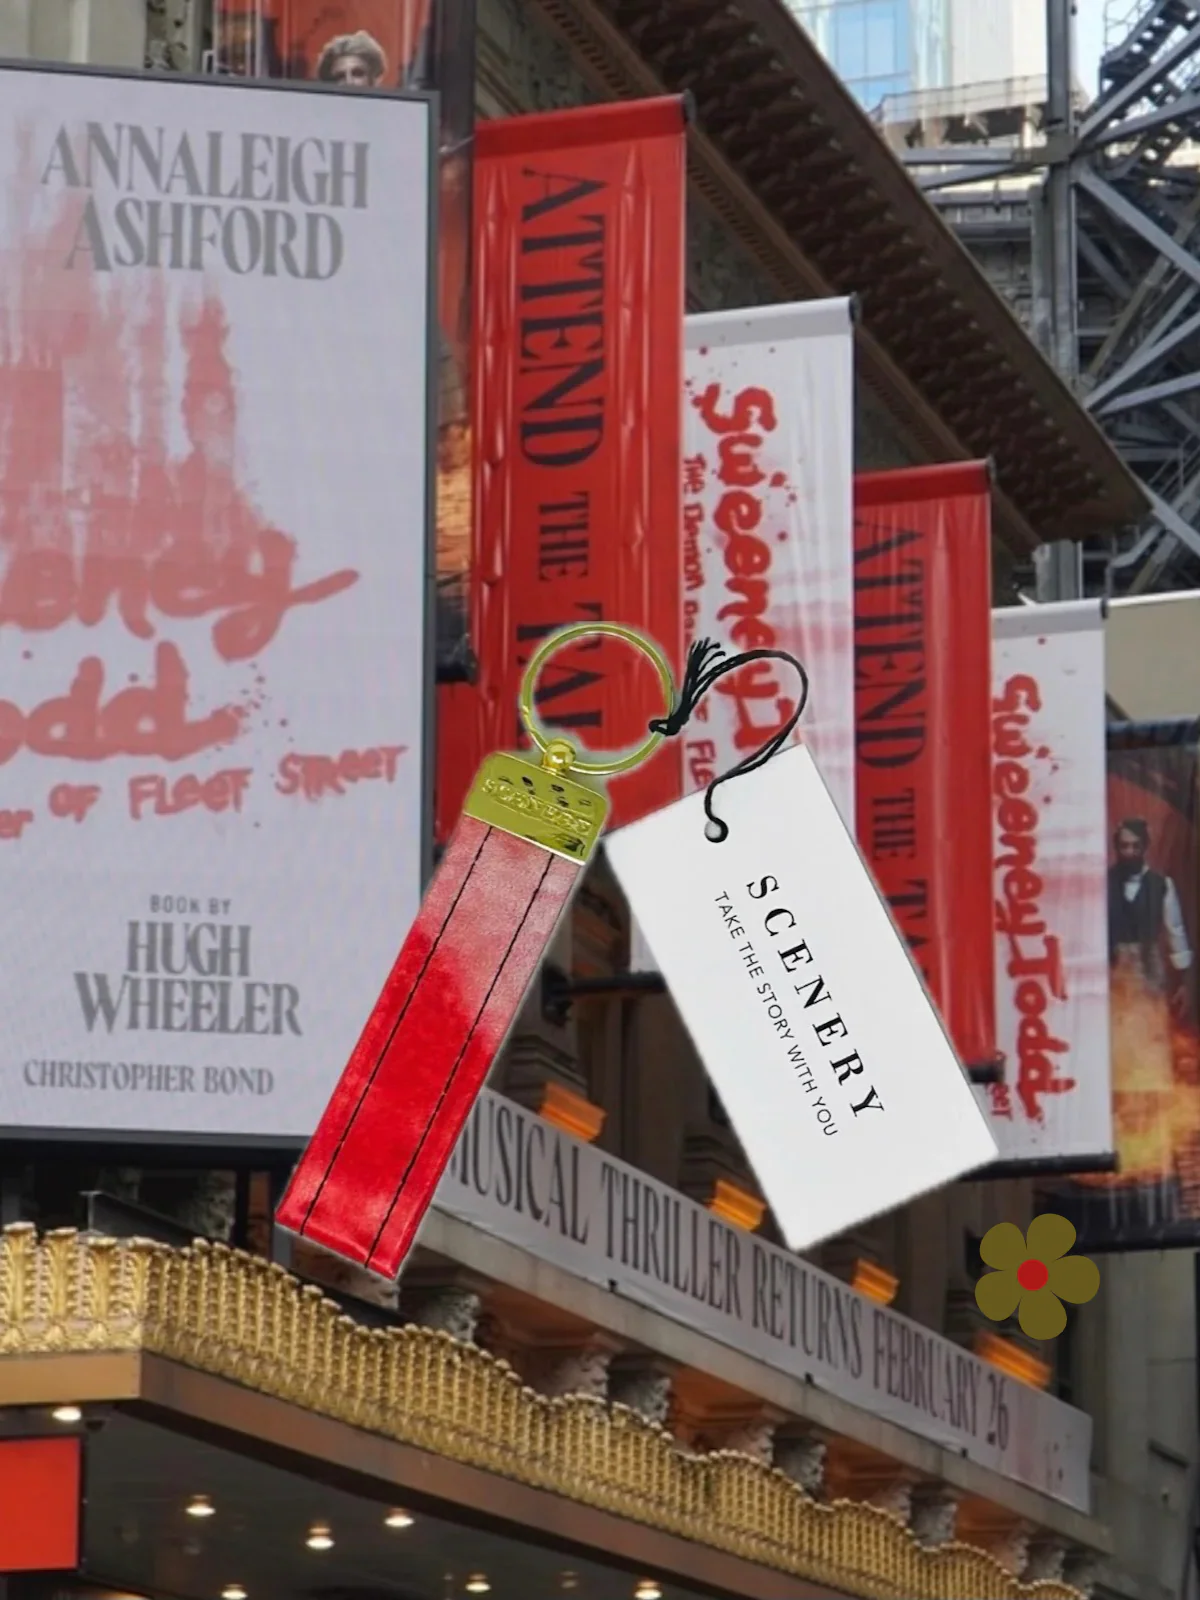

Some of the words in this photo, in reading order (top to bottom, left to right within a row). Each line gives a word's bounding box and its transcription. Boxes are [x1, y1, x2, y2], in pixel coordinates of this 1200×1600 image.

[41, 121, 370, 209] ANNALEIGH
[64, 194, 344, 281] ASHFORD
[519, 167, 608, 468] ATTEND
[538, 491, 589, 582] THE
[516, 602, 603, 751] TAL
[854, 519, 926, 769] ATTEND
[873, 787, 916, 861] THE
[126, 920, 252, 977] HUGH
[150, 894, 200, 914] BOOK
[209, 898, 231, 915] BY
[73, 971, 304, 1036] WHEELER
[714, 891, 745, 940] TAKE
[738, 941, 764, 979] THE
[757, 982, 795, 1041] STORY
[787, 1044, 818, 1094] WITH
[811, 1096, 838, 1137] YOU
[746, 875, 885, 1118] SCENERY
[24, 1059, 196, 1093] CHRISTOPHER
[204, 1066, 275, 1096] BOND
[602, 1160, 742, 1320] THRILLER
[752, 1243, 864, 1380] RETURNS
[872, 1309, 982, 1438] FEBRUARY
[986, 1373, 1010, 1452] 26
